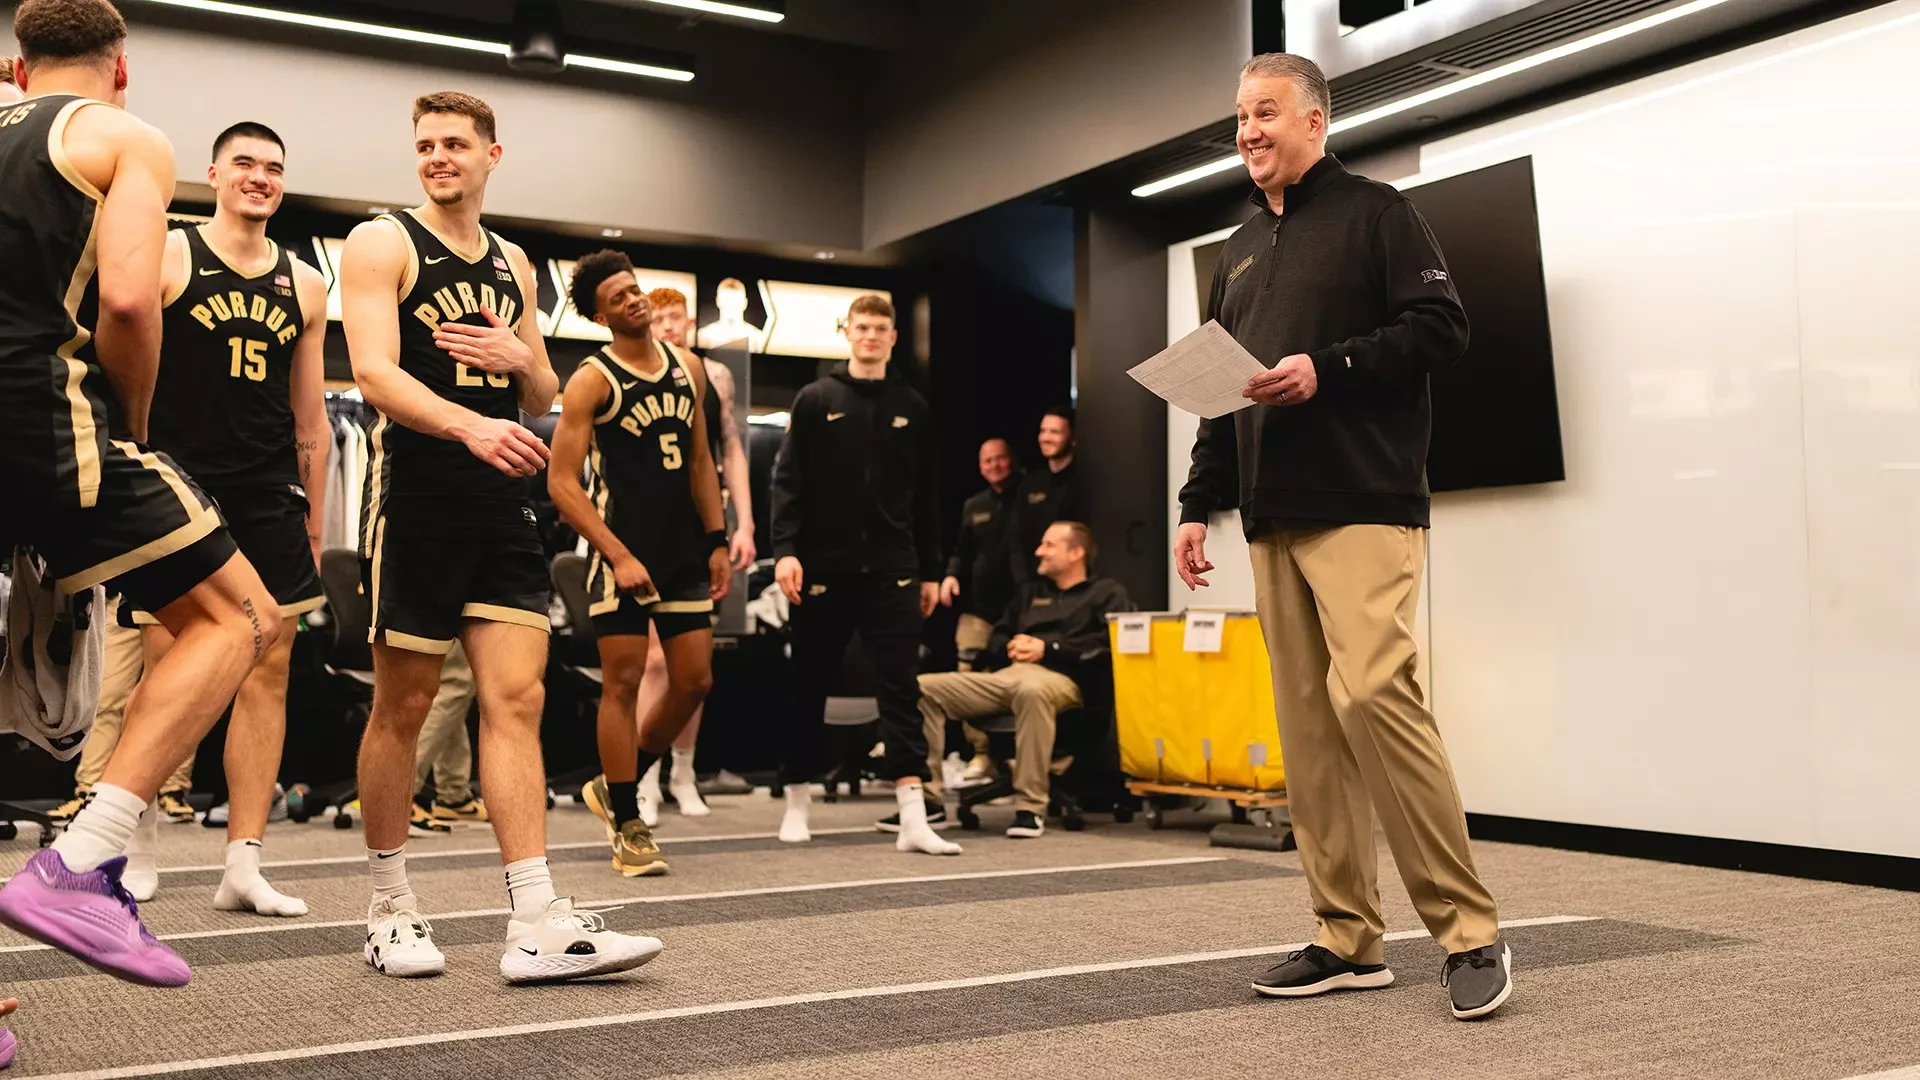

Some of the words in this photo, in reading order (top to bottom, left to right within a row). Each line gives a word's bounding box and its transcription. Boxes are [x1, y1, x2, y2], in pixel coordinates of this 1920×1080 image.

[190, 291, 297, 345] PURDUE
[228, 336, 268, 382] 15
[659, 432, 683, 470] 5
